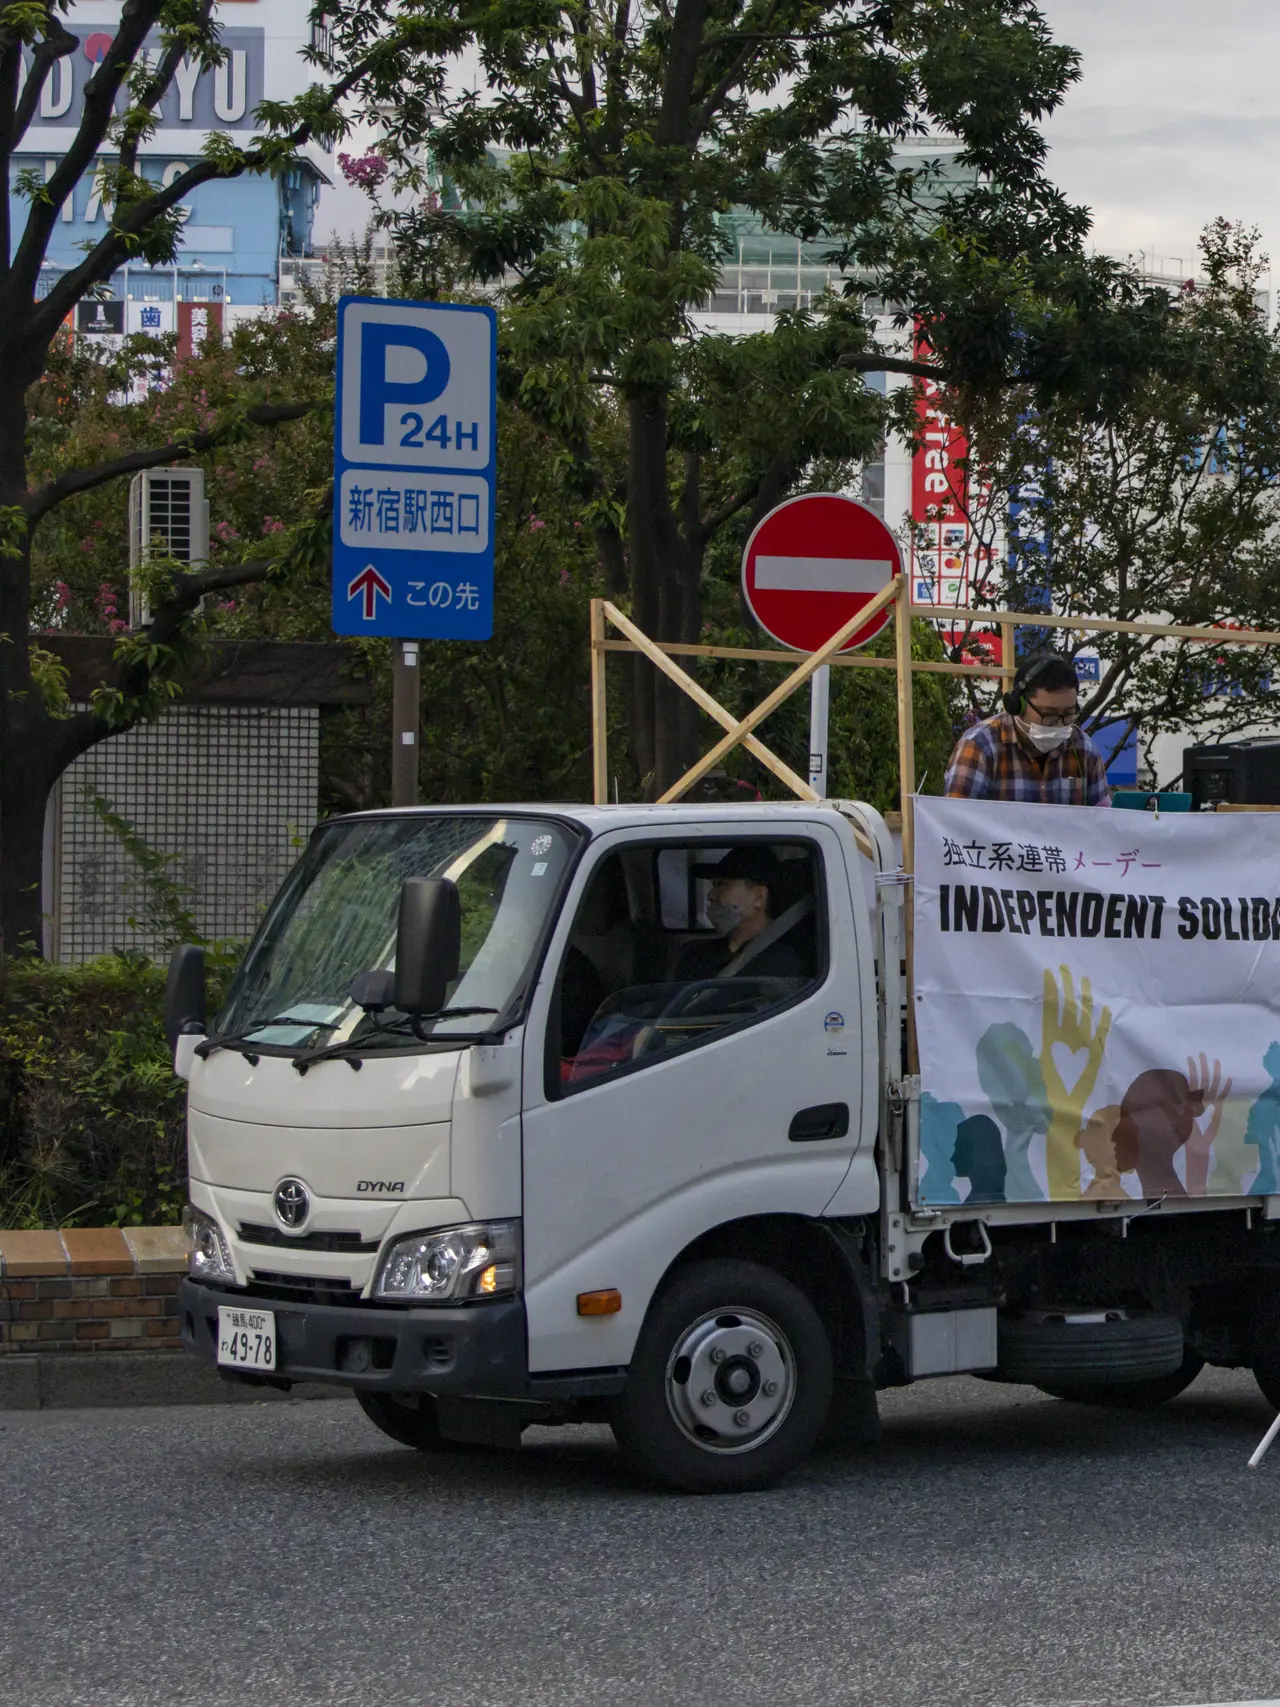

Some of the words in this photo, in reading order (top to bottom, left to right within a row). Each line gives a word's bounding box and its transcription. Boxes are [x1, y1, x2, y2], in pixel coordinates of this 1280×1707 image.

[359, 322, 451, 446] P
[400, 411, 478, 451] 24H
[348, 484, 480, 536] 新宿駅西口
[406, 581, 480, 611] この先
[943, 836, 1067, 874] 独立系連帯
[939, 884, 1166, 939] INDEPENDENT
[356, 1180, 405, 1193] DYNA
[230, 1331, 272, 1365] 49-78
